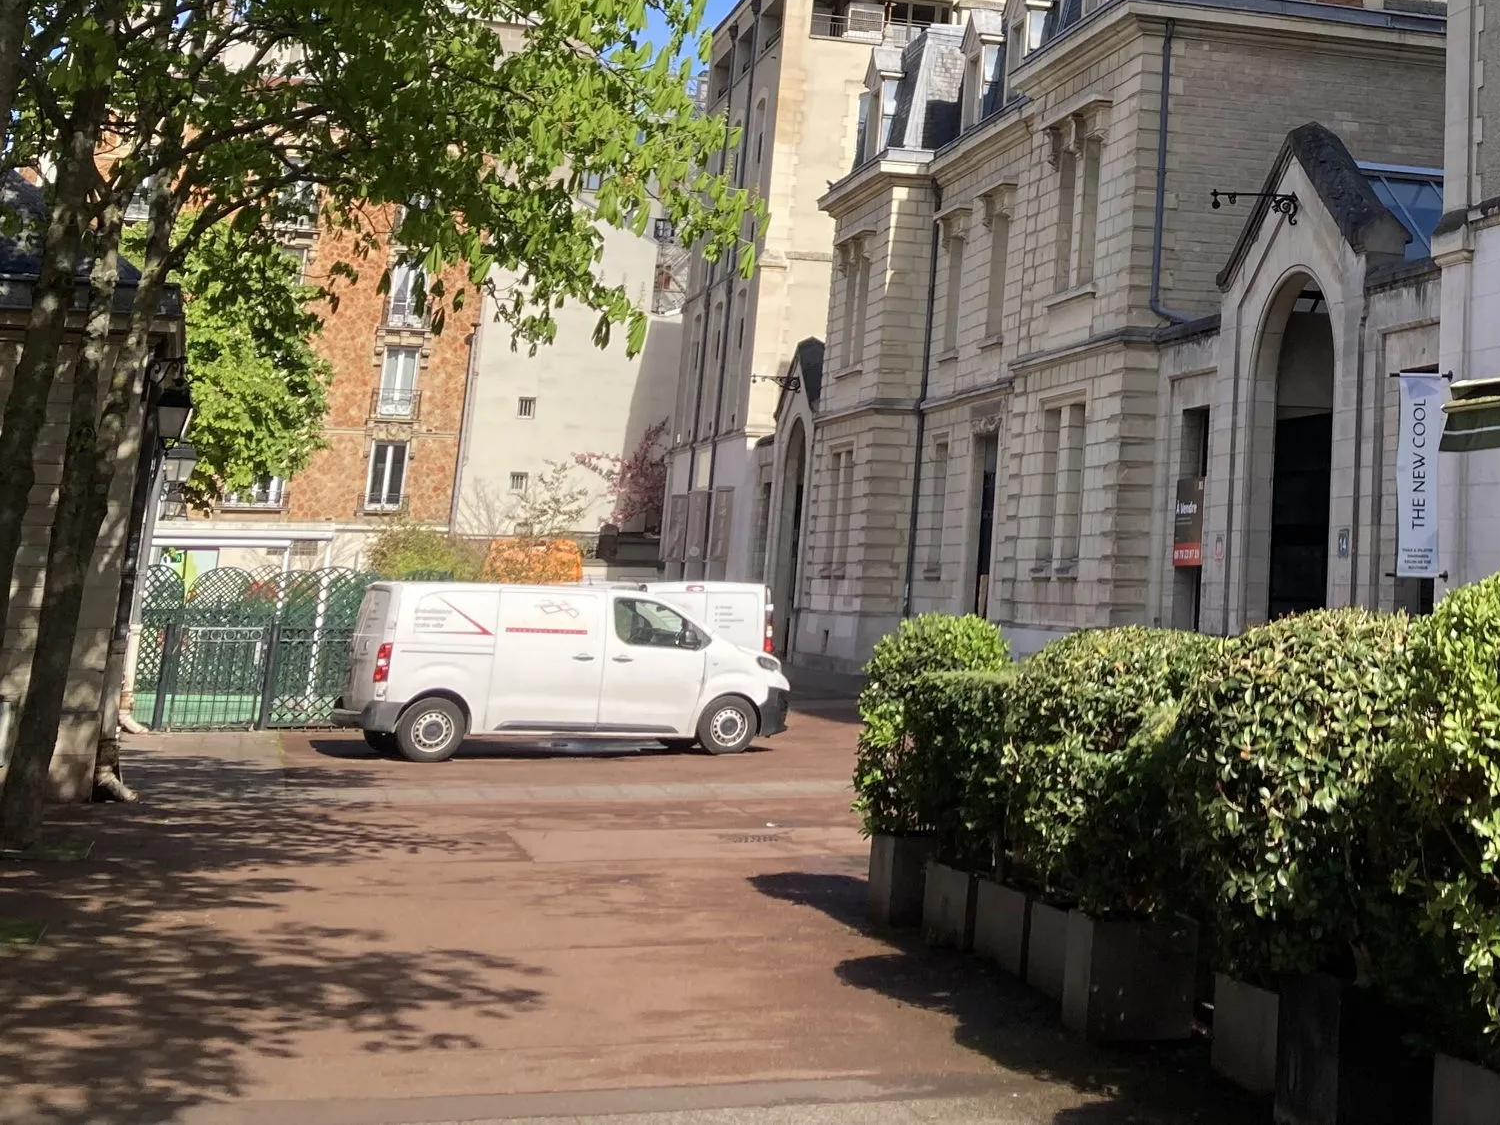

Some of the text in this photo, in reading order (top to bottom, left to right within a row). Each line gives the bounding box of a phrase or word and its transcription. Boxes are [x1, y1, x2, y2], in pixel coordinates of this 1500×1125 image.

[1411, 398, 1427, 530] THE NEW COOL
